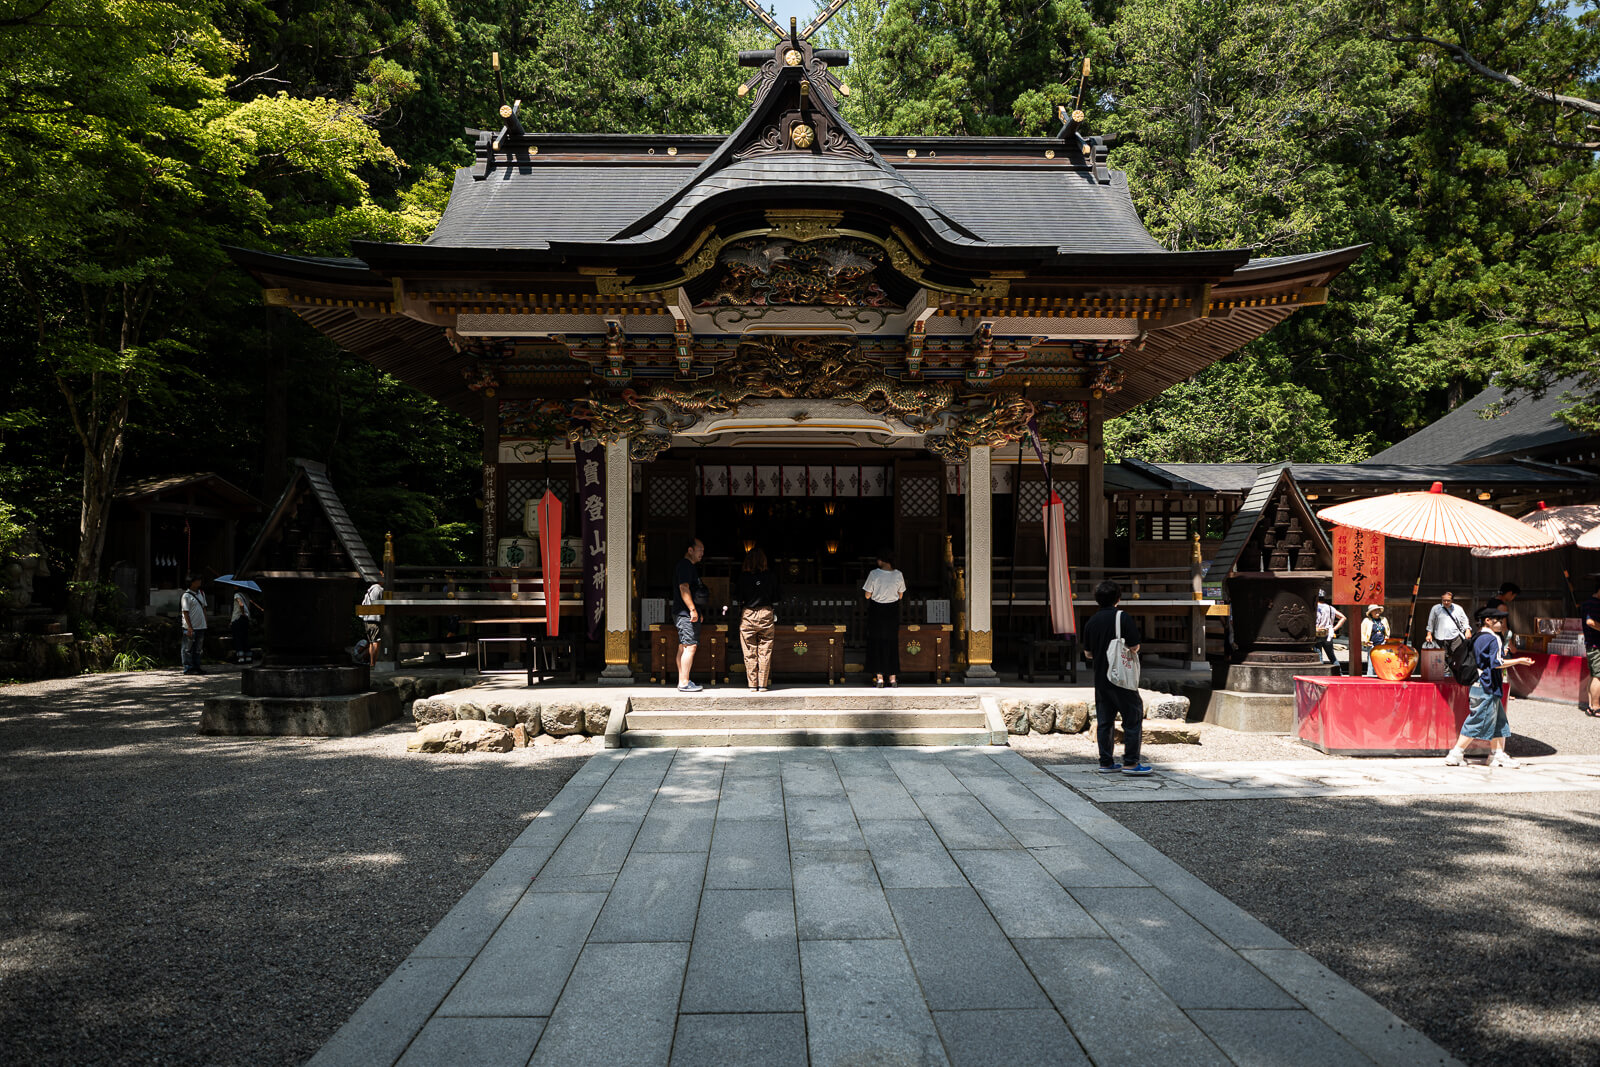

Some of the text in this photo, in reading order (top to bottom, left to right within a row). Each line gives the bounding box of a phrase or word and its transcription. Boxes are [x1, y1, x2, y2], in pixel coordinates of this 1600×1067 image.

[1338, 535, 1348, 577] 招福開運
[1370, 534, 1379, 576] 金運円満
